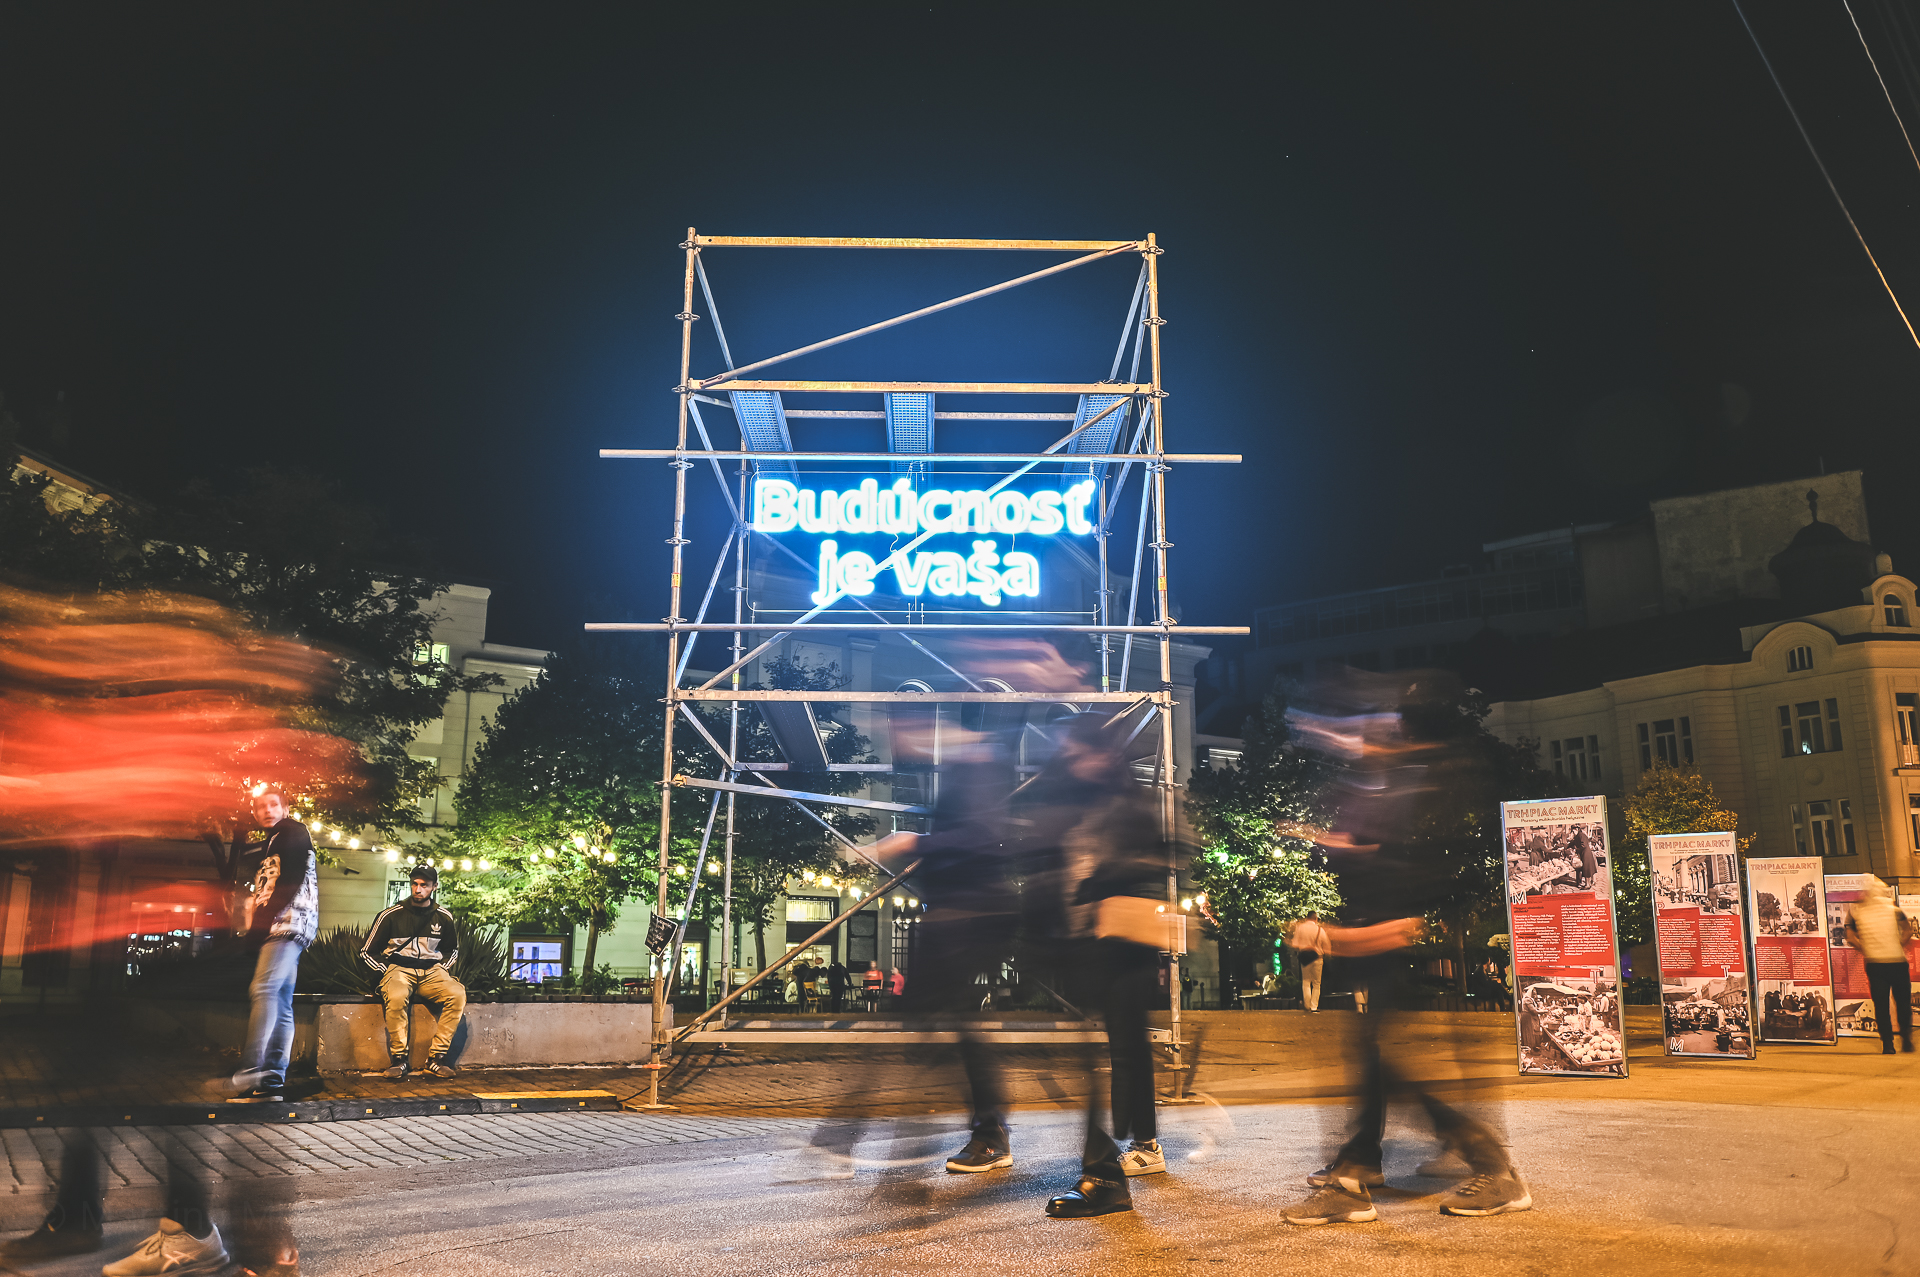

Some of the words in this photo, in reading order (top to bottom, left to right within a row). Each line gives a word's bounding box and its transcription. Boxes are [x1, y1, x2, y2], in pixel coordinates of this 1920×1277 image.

[754, 478, 1095, 535] Budúcnosť
[812, 540, 876, 605] je
[891, 540, 1040, 606] vaša
